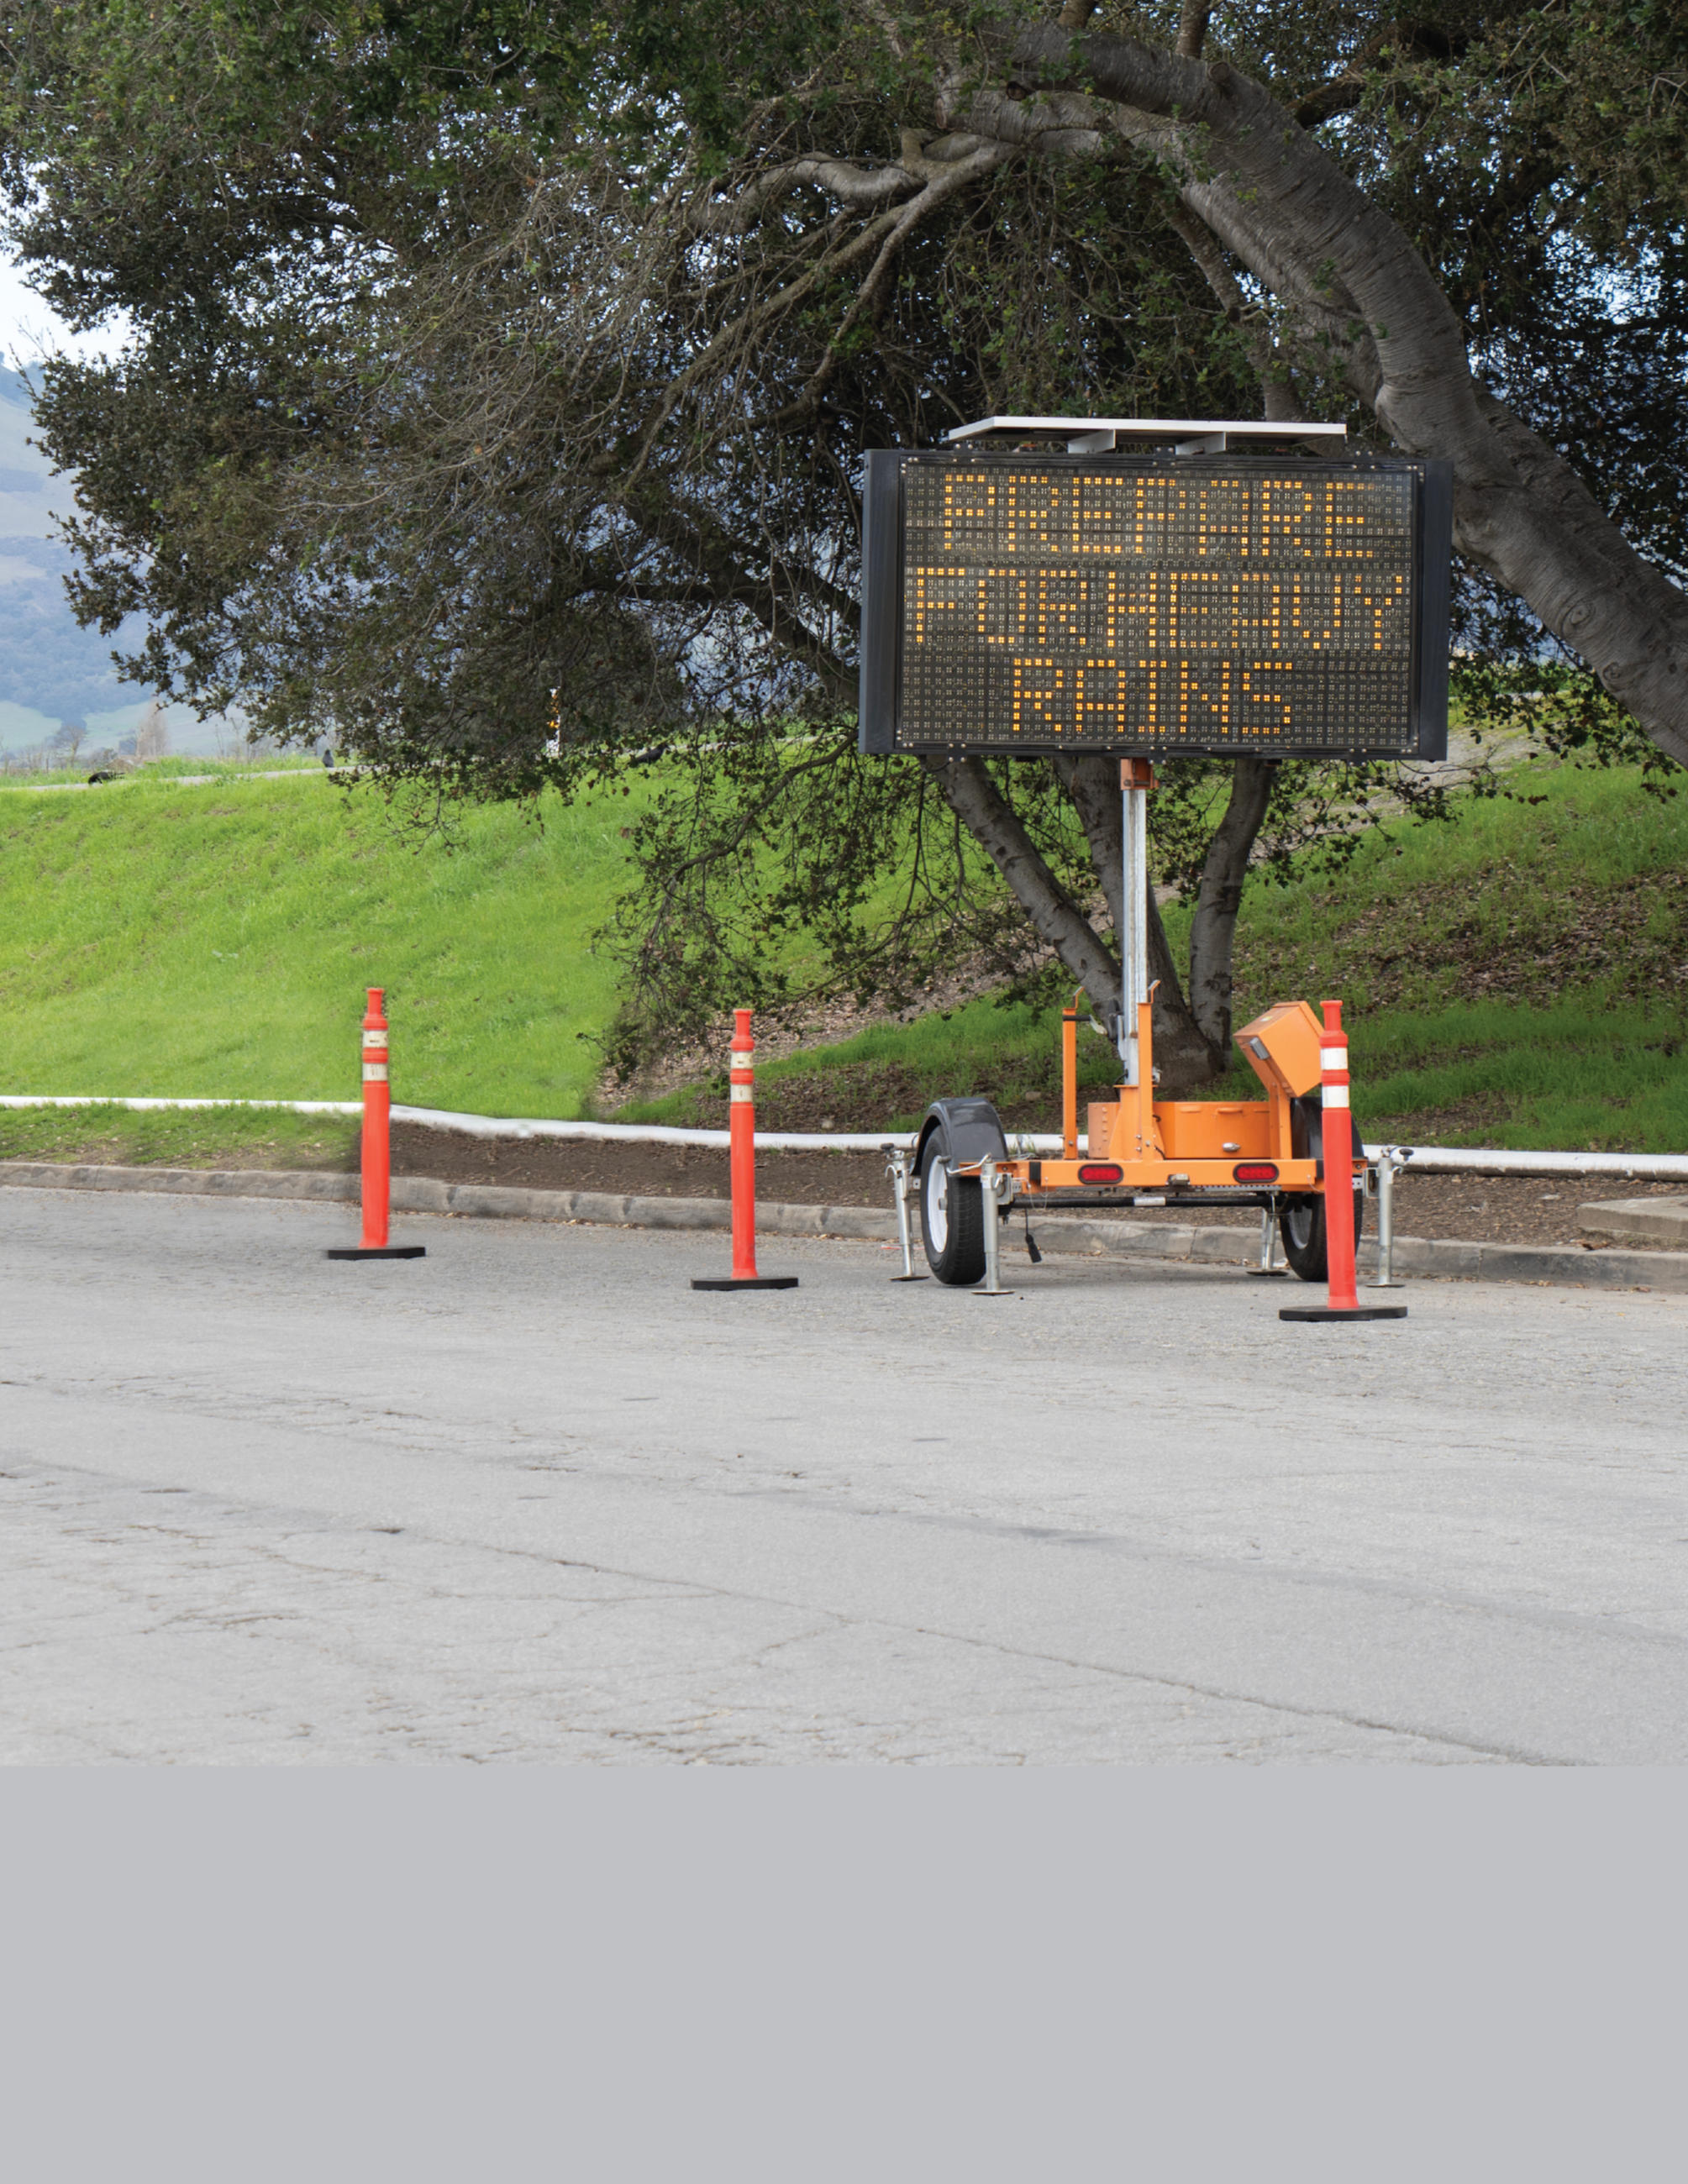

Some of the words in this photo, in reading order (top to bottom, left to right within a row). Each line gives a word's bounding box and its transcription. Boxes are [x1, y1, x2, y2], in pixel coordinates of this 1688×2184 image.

[944, 475, 1375, 557] PREPARE
[917, 567, 1087, 645] FOR
[1107, 571, 1402, 650] HEAVY
[1012, 658, 1292, 733] RAINS
